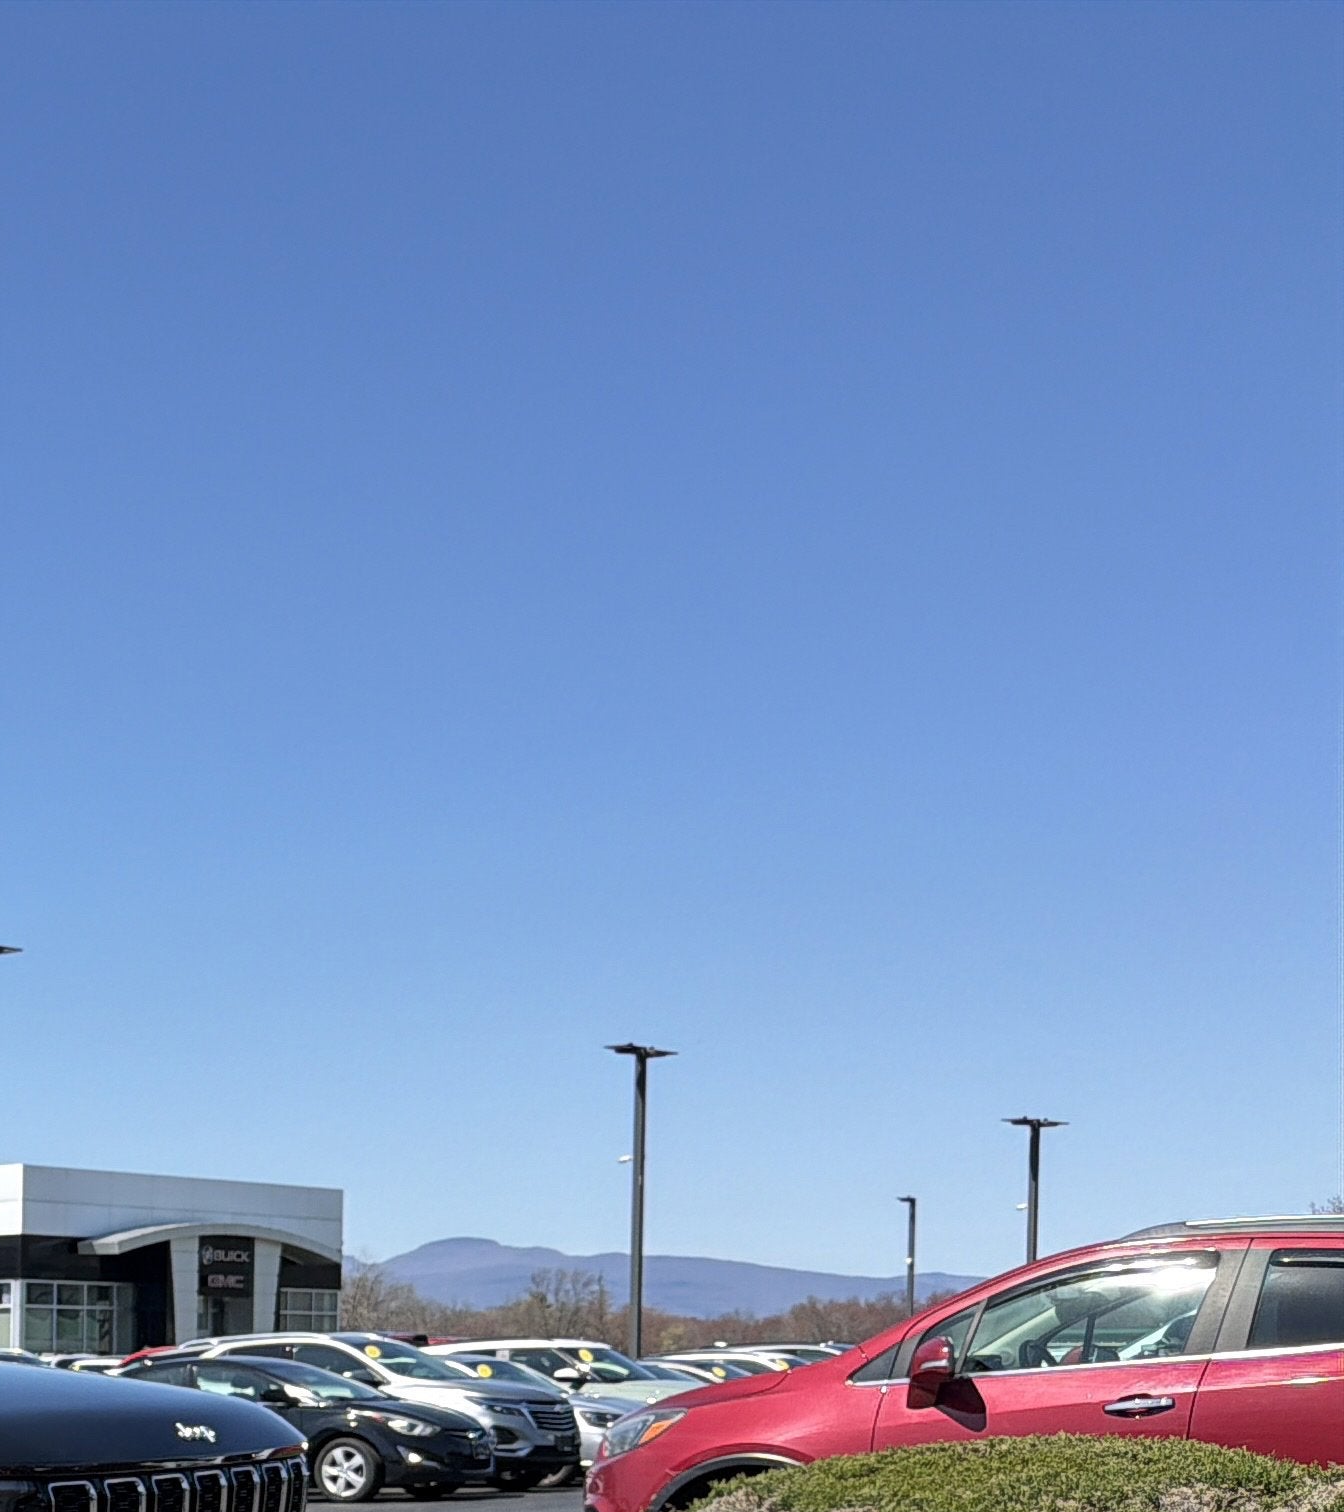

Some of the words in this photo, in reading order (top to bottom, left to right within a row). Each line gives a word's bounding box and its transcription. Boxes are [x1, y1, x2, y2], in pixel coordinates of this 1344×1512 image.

[213, 1249, 250, 1263] BUICK
[207, 1274, 245, 1289] GMC
[175, 1422, 216, 1443] Jeep
